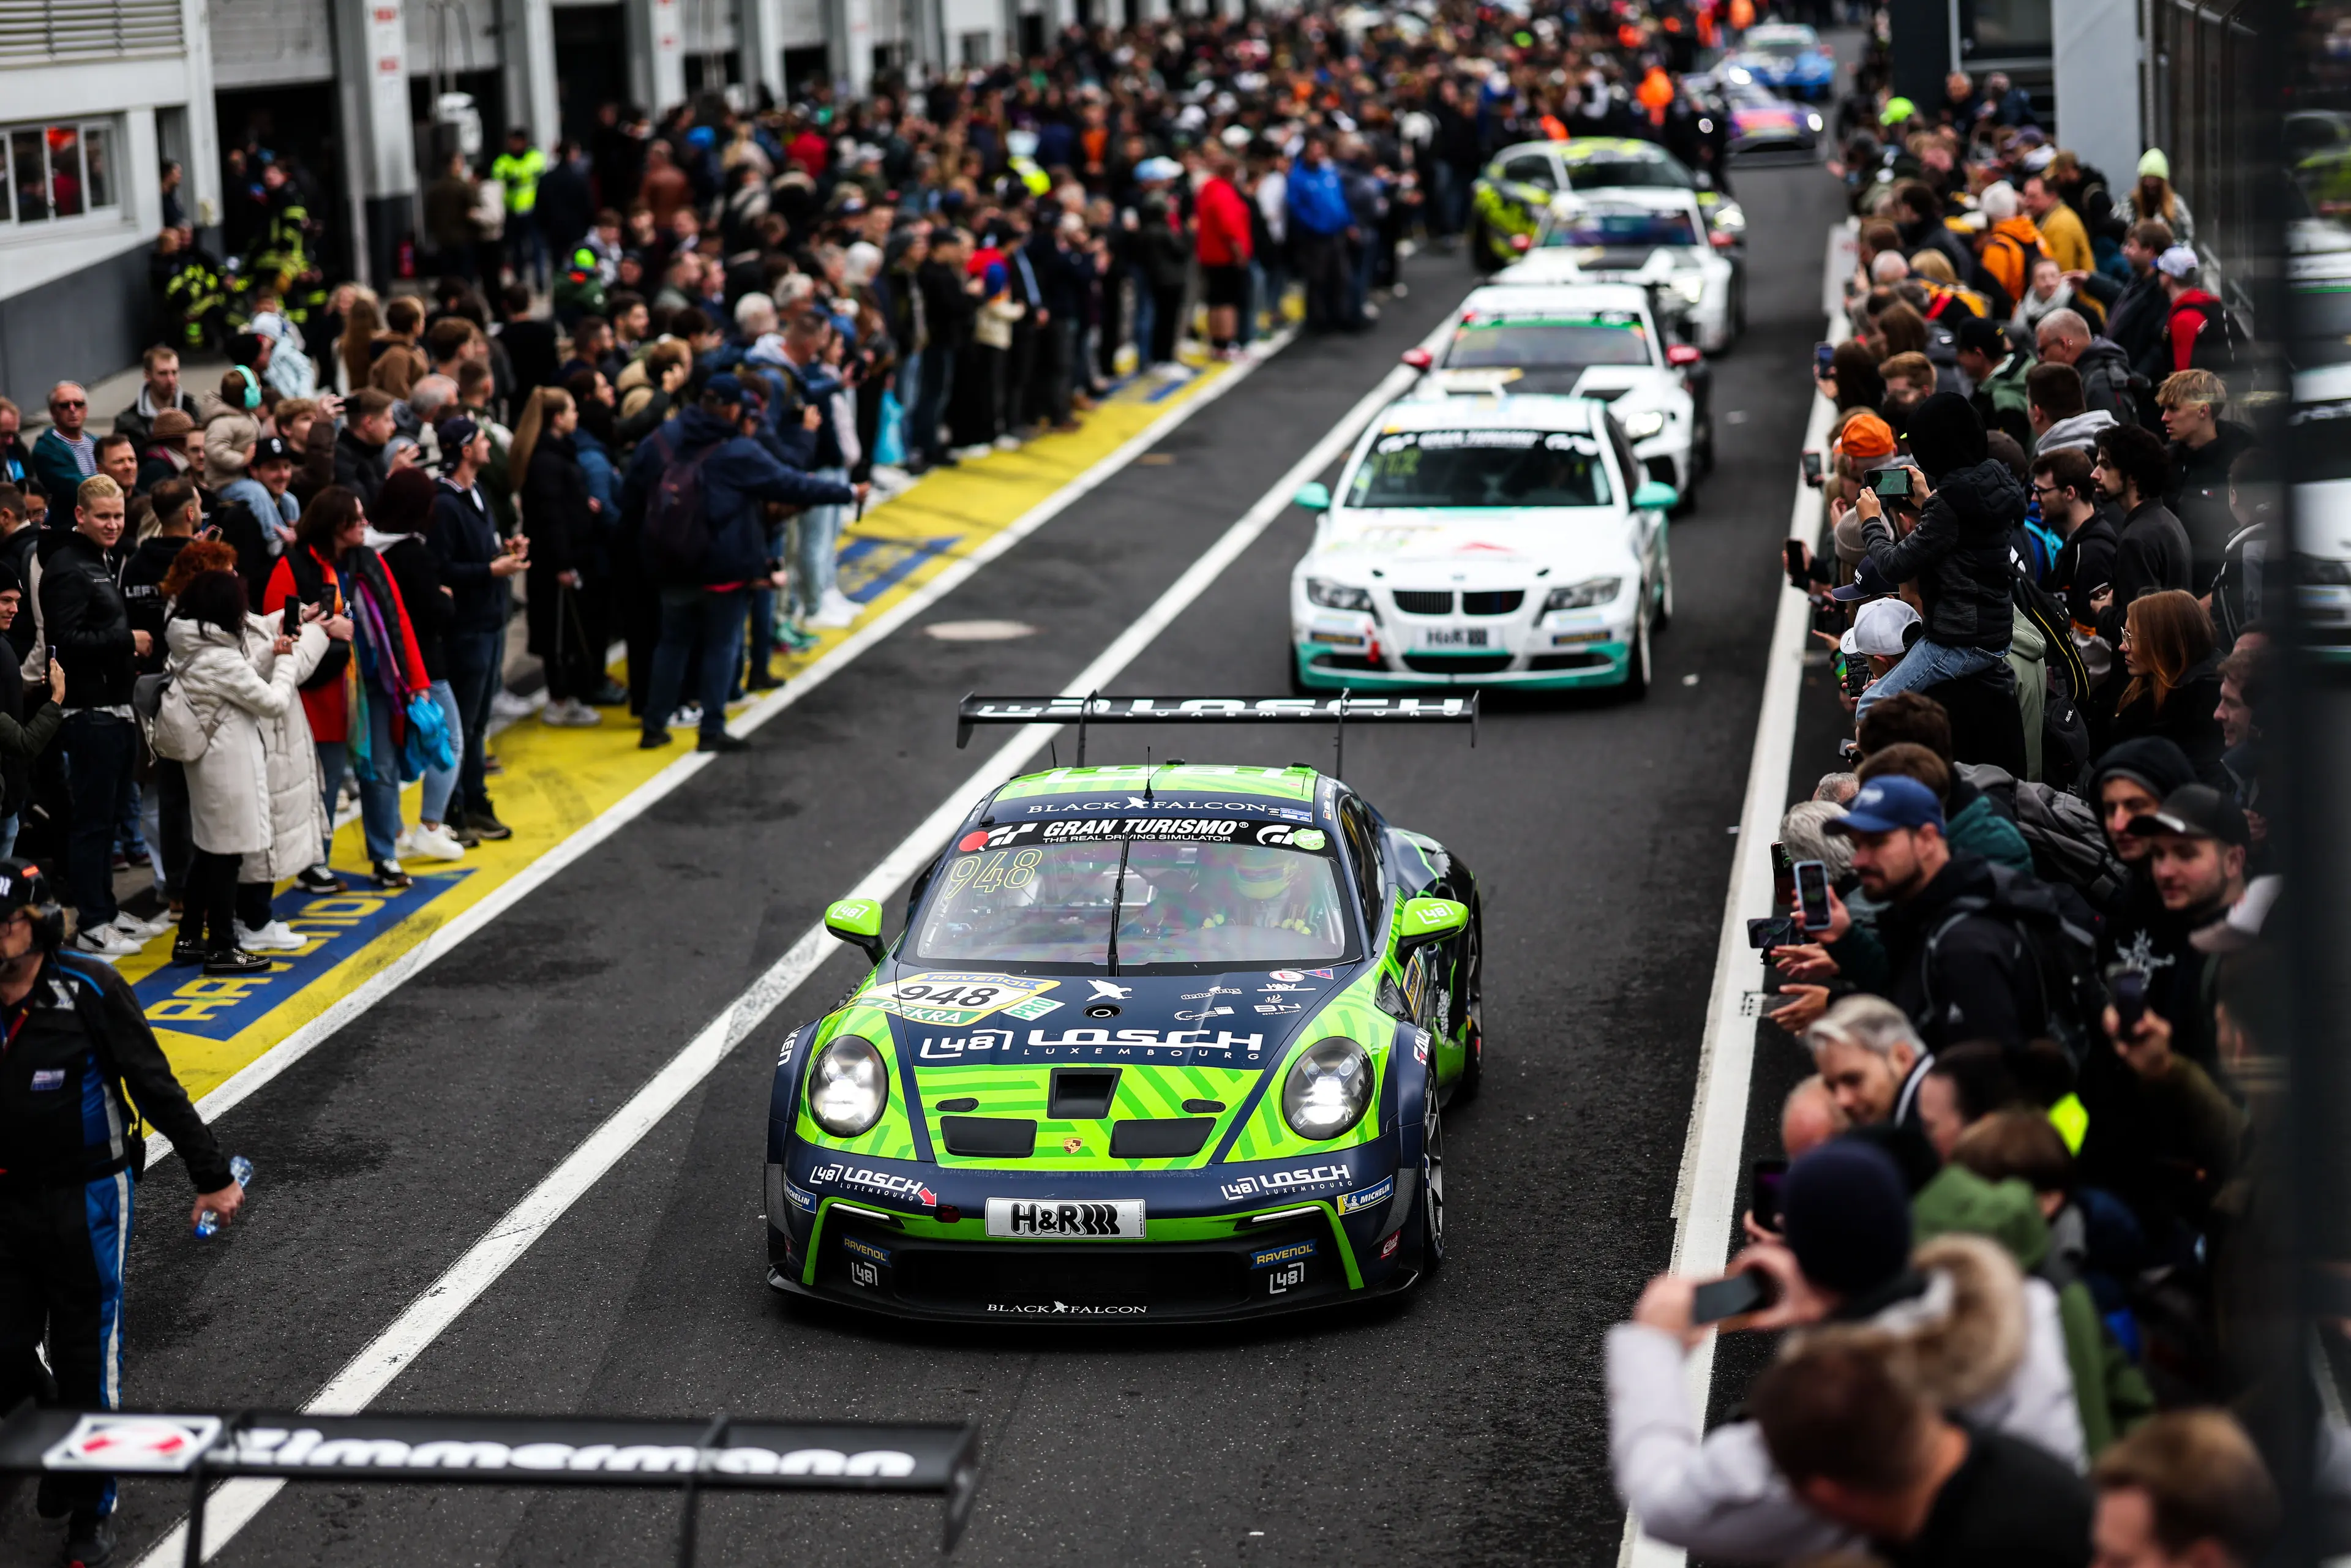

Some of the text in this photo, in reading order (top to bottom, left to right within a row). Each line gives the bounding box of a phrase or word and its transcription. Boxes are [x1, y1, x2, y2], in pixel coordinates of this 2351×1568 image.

[1027, 801, 1122, 814] BLACK
[1152, 801, 1269, 812] FALCON
[1043, 819, 1119, 837] GRAN
[945, 849, 1043, 899] 948
[929, 975, 1035, 988] RAVENOL
[891, 985, 1000, 1007] 948
[876, 1000, 962, 1024] DEKRA
[1010, 998, 1057, 1019] PRO
[1027, 1029, 1264, 1051] LOSCH
[1024, 1048, 1259, 1060] LUXEMBOURG
[843, 1166, 924, 1195] LOSCH
[1259, 1164, 1351, 1188] LOSCH
[840, 1182, 914, 1201] LUXEMBOURG
[1265, 1180, 1353, 1196] LUXEMBOURG
[1360, 1182, 1390, 1204] MICHELIN
[844, 1238, 887, 1262] RAVENOL
[1256, 1244, 1313, 1264] RAVENOL
[987, 1304, 1049, 1313] BLACK
